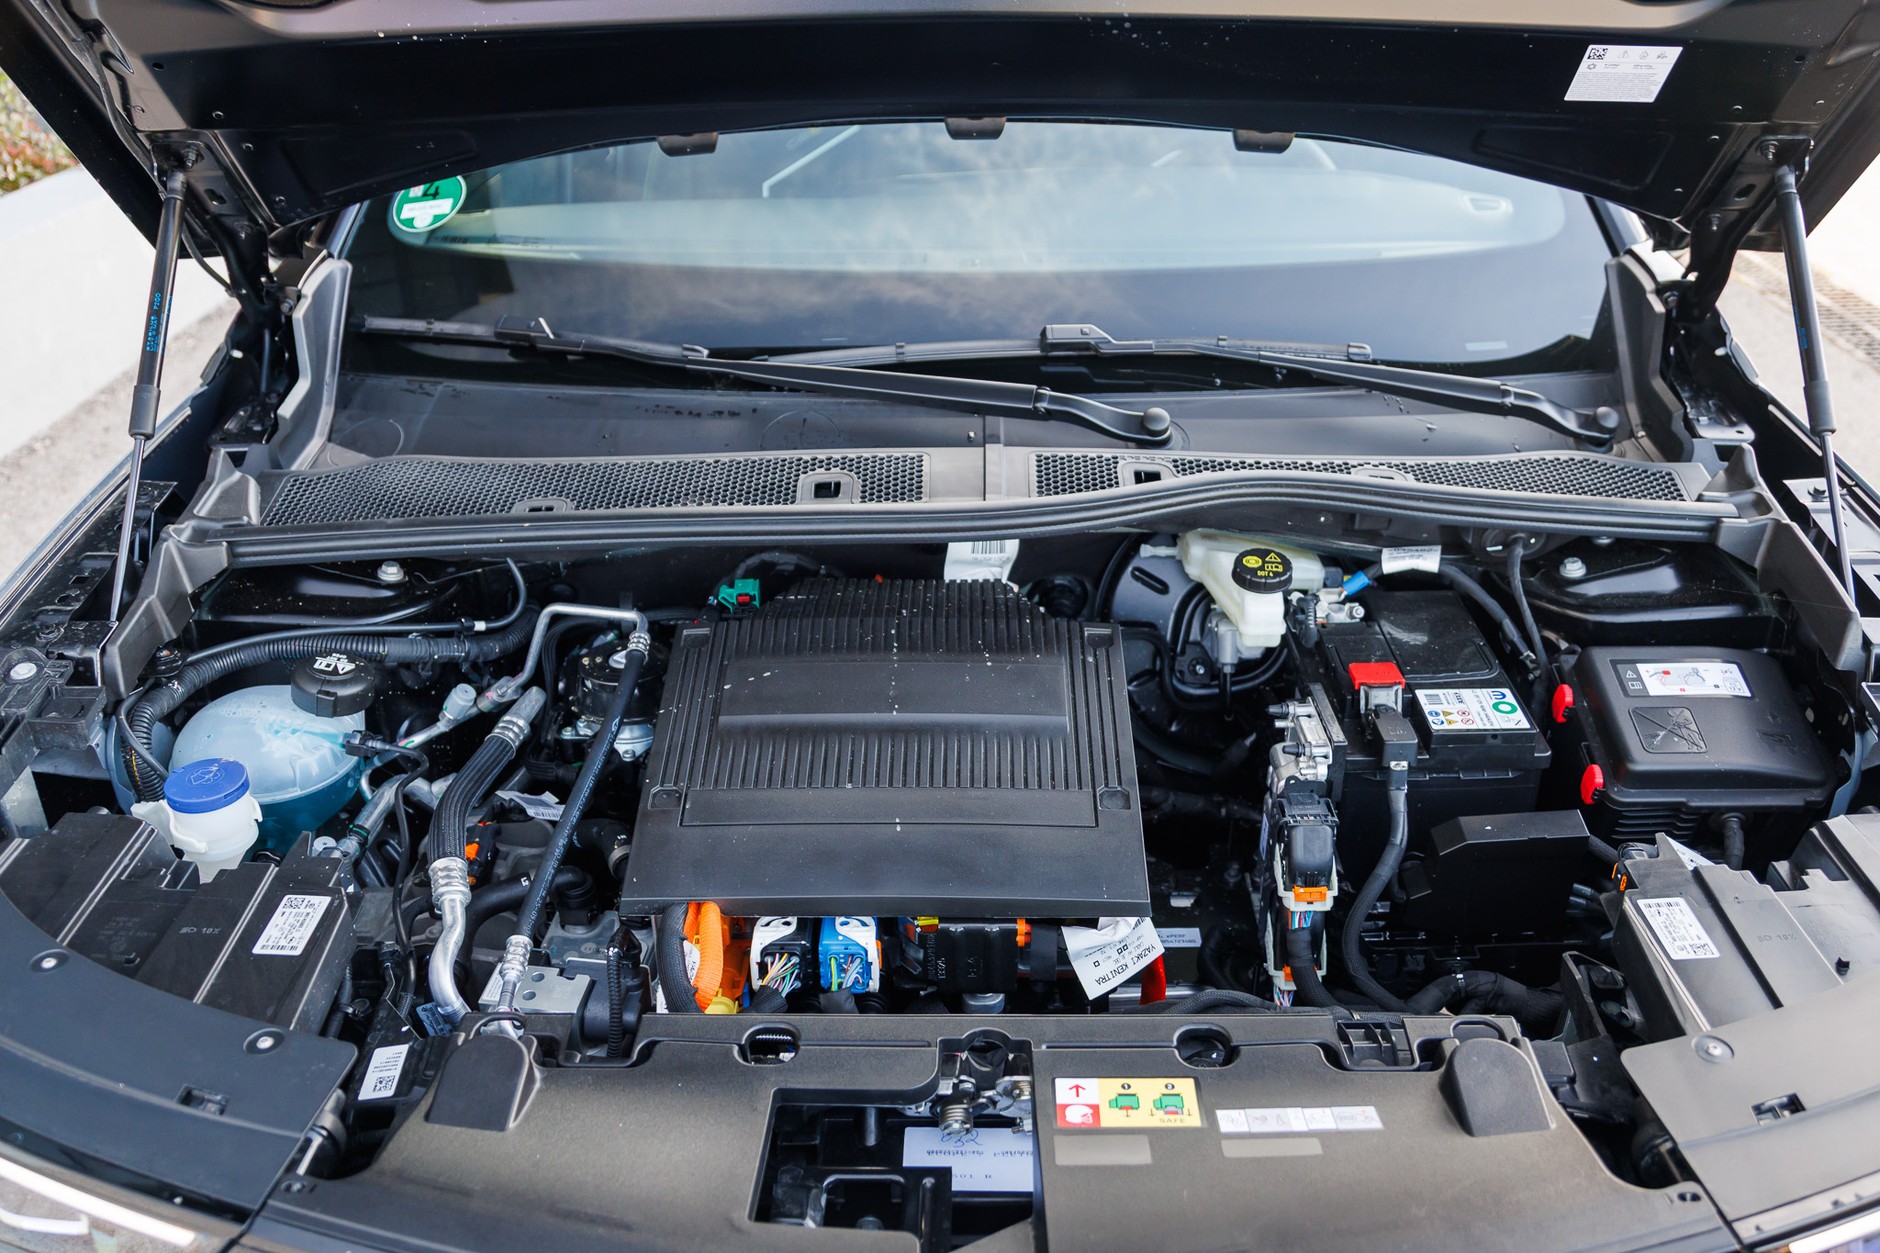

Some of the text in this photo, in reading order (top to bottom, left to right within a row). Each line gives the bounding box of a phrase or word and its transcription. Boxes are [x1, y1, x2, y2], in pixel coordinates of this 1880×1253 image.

[421, 181, 439, 199] 4
[153, 292, 161, 310] P200
[1132, 943, 1156, 966] YAZAKI
[1094, 963, 1129, 986] KENITRA
